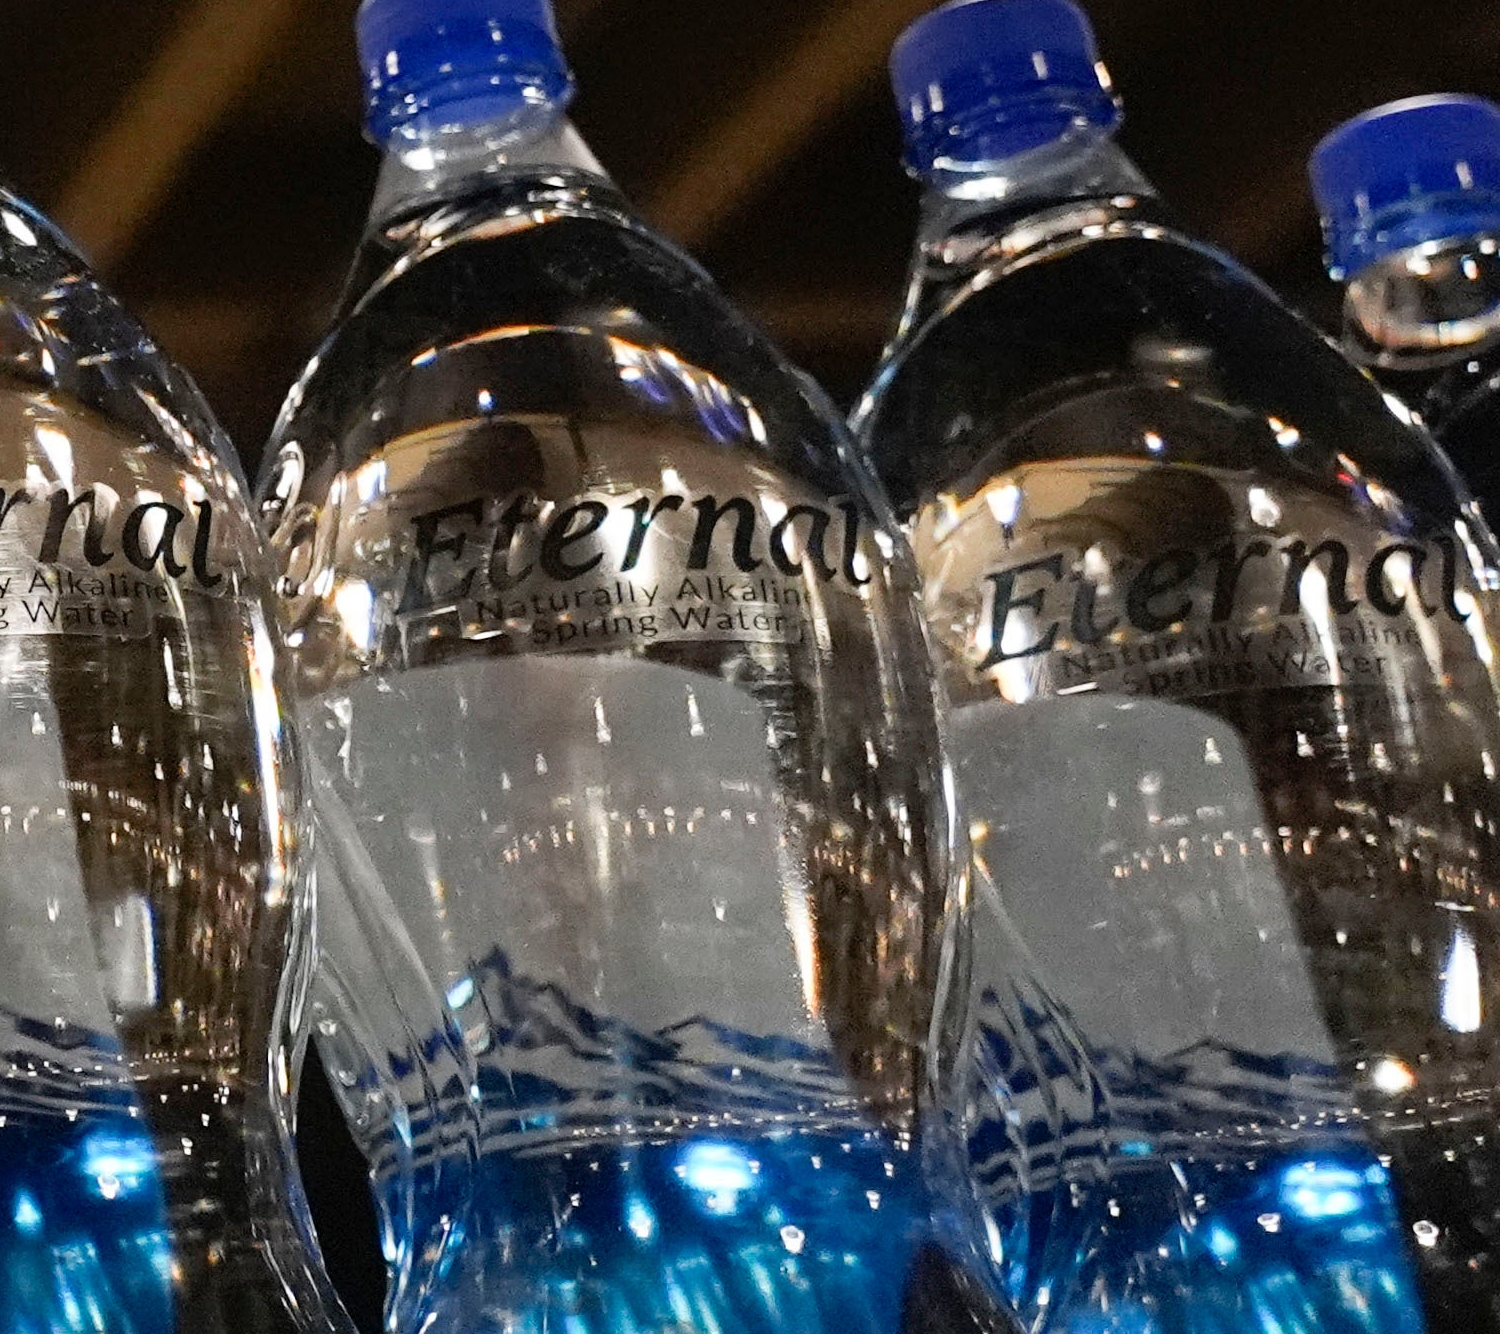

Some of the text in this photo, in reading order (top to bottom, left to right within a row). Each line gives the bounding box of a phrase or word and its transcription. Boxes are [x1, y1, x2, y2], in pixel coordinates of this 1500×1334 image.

[398, 493, 871, 613] Eternal
[28, 571, 169, 604] Alkaline
[477, 580, 658, 623] Naturally
[22, 599, 133, 629] Water
[533, 605, 785, 645] Spring Water
